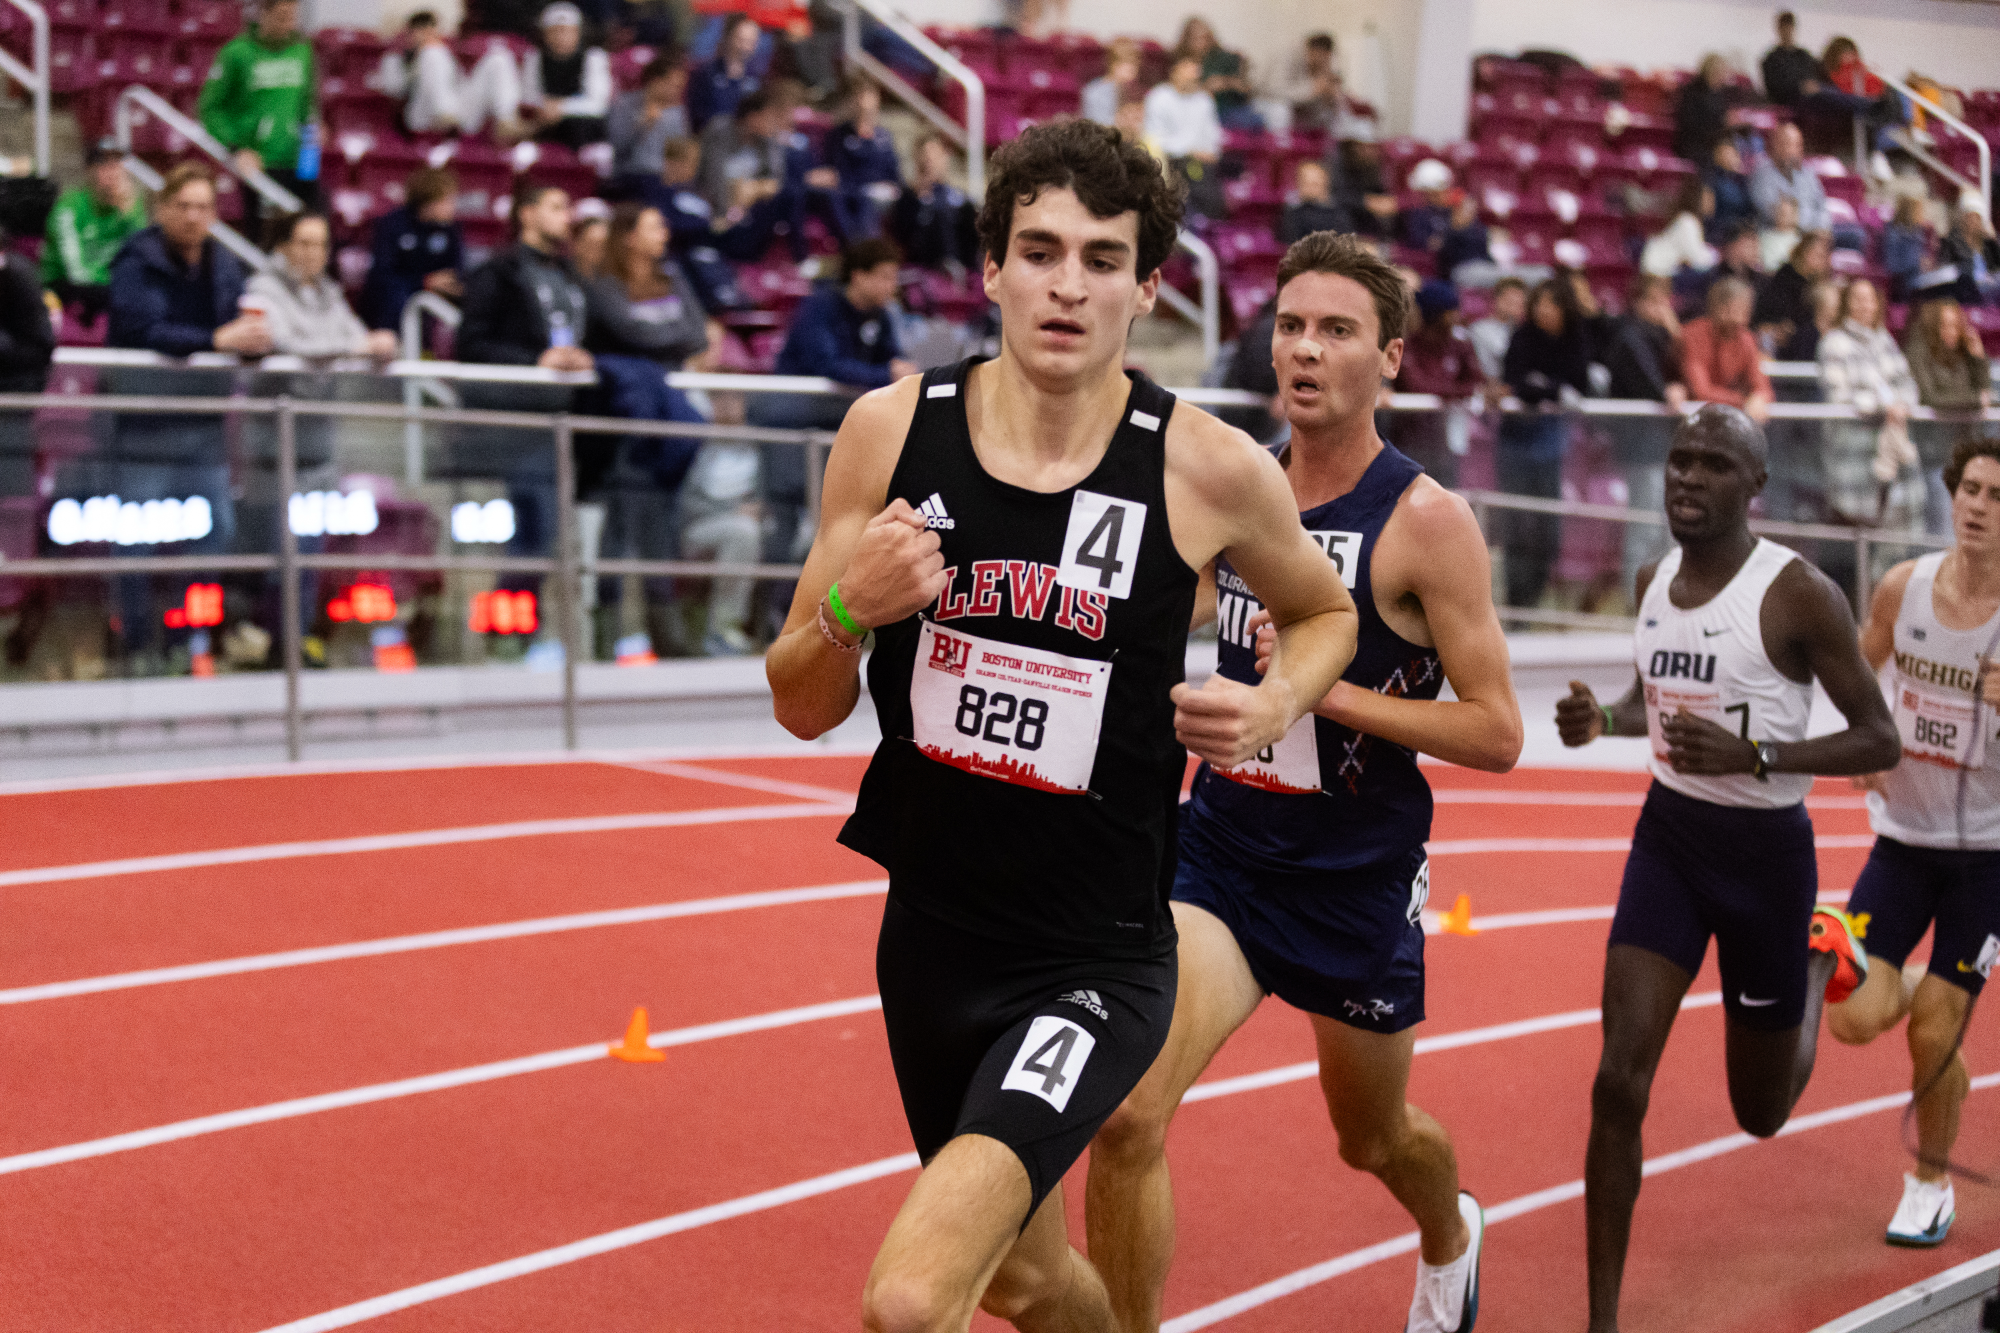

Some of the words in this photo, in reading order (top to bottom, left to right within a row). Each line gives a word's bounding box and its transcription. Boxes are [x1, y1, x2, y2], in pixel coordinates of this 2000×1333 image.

[1075, 504, 1126, 589] 4
[934, 560, 1109, 641] LEWIS
[930, 632, 972, 670] BU
[981, 652, 1023, 671] BOSTON
[1025, 661, 1093, 684] UNIVERSITY
[1650, 650, 1716, 683] ORU
[954, 684, 1049, 751] 828
[1915, 716, 1957, 751] 862
[1021, 1025, 1079, 1096] 4
